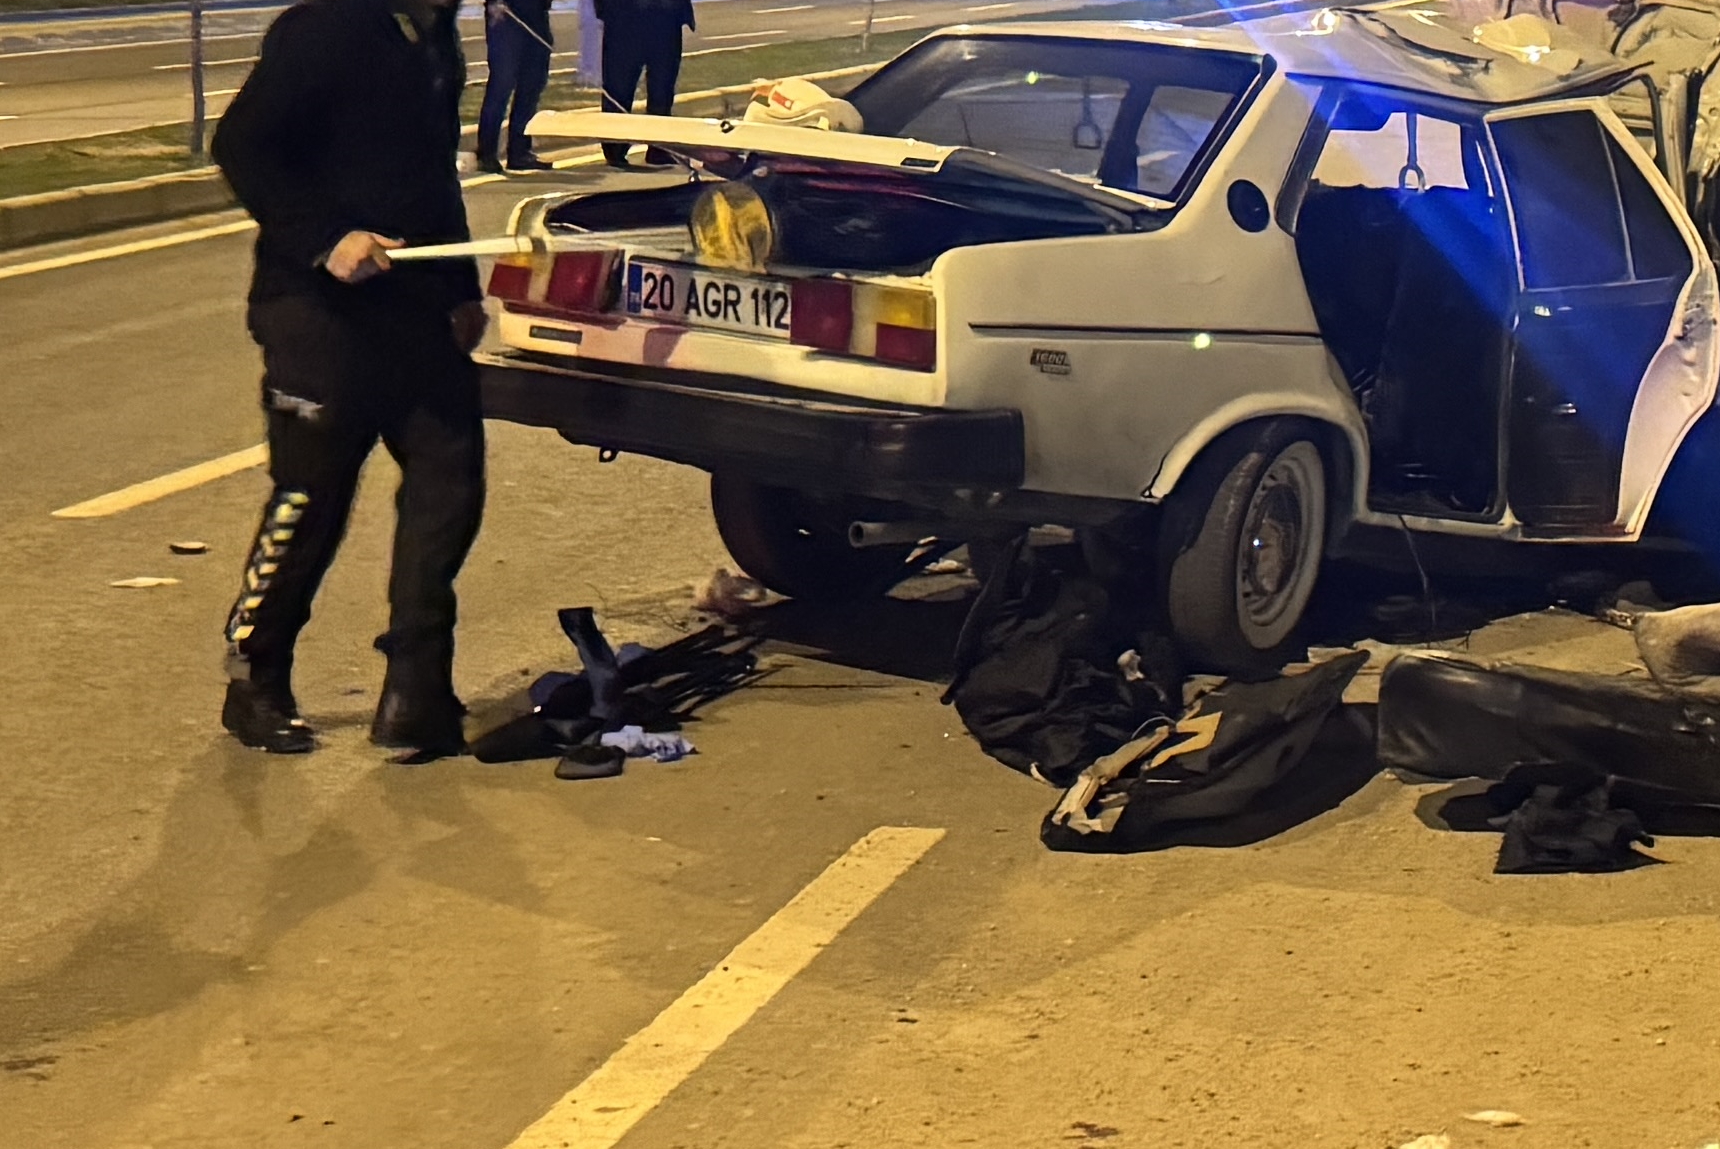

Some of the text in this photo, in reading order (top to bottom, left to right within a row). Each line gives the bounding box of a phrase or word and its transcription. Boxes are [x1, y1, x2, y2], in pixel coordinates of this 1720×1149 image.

[643, 271, 790, 331] 20 AGR 112
